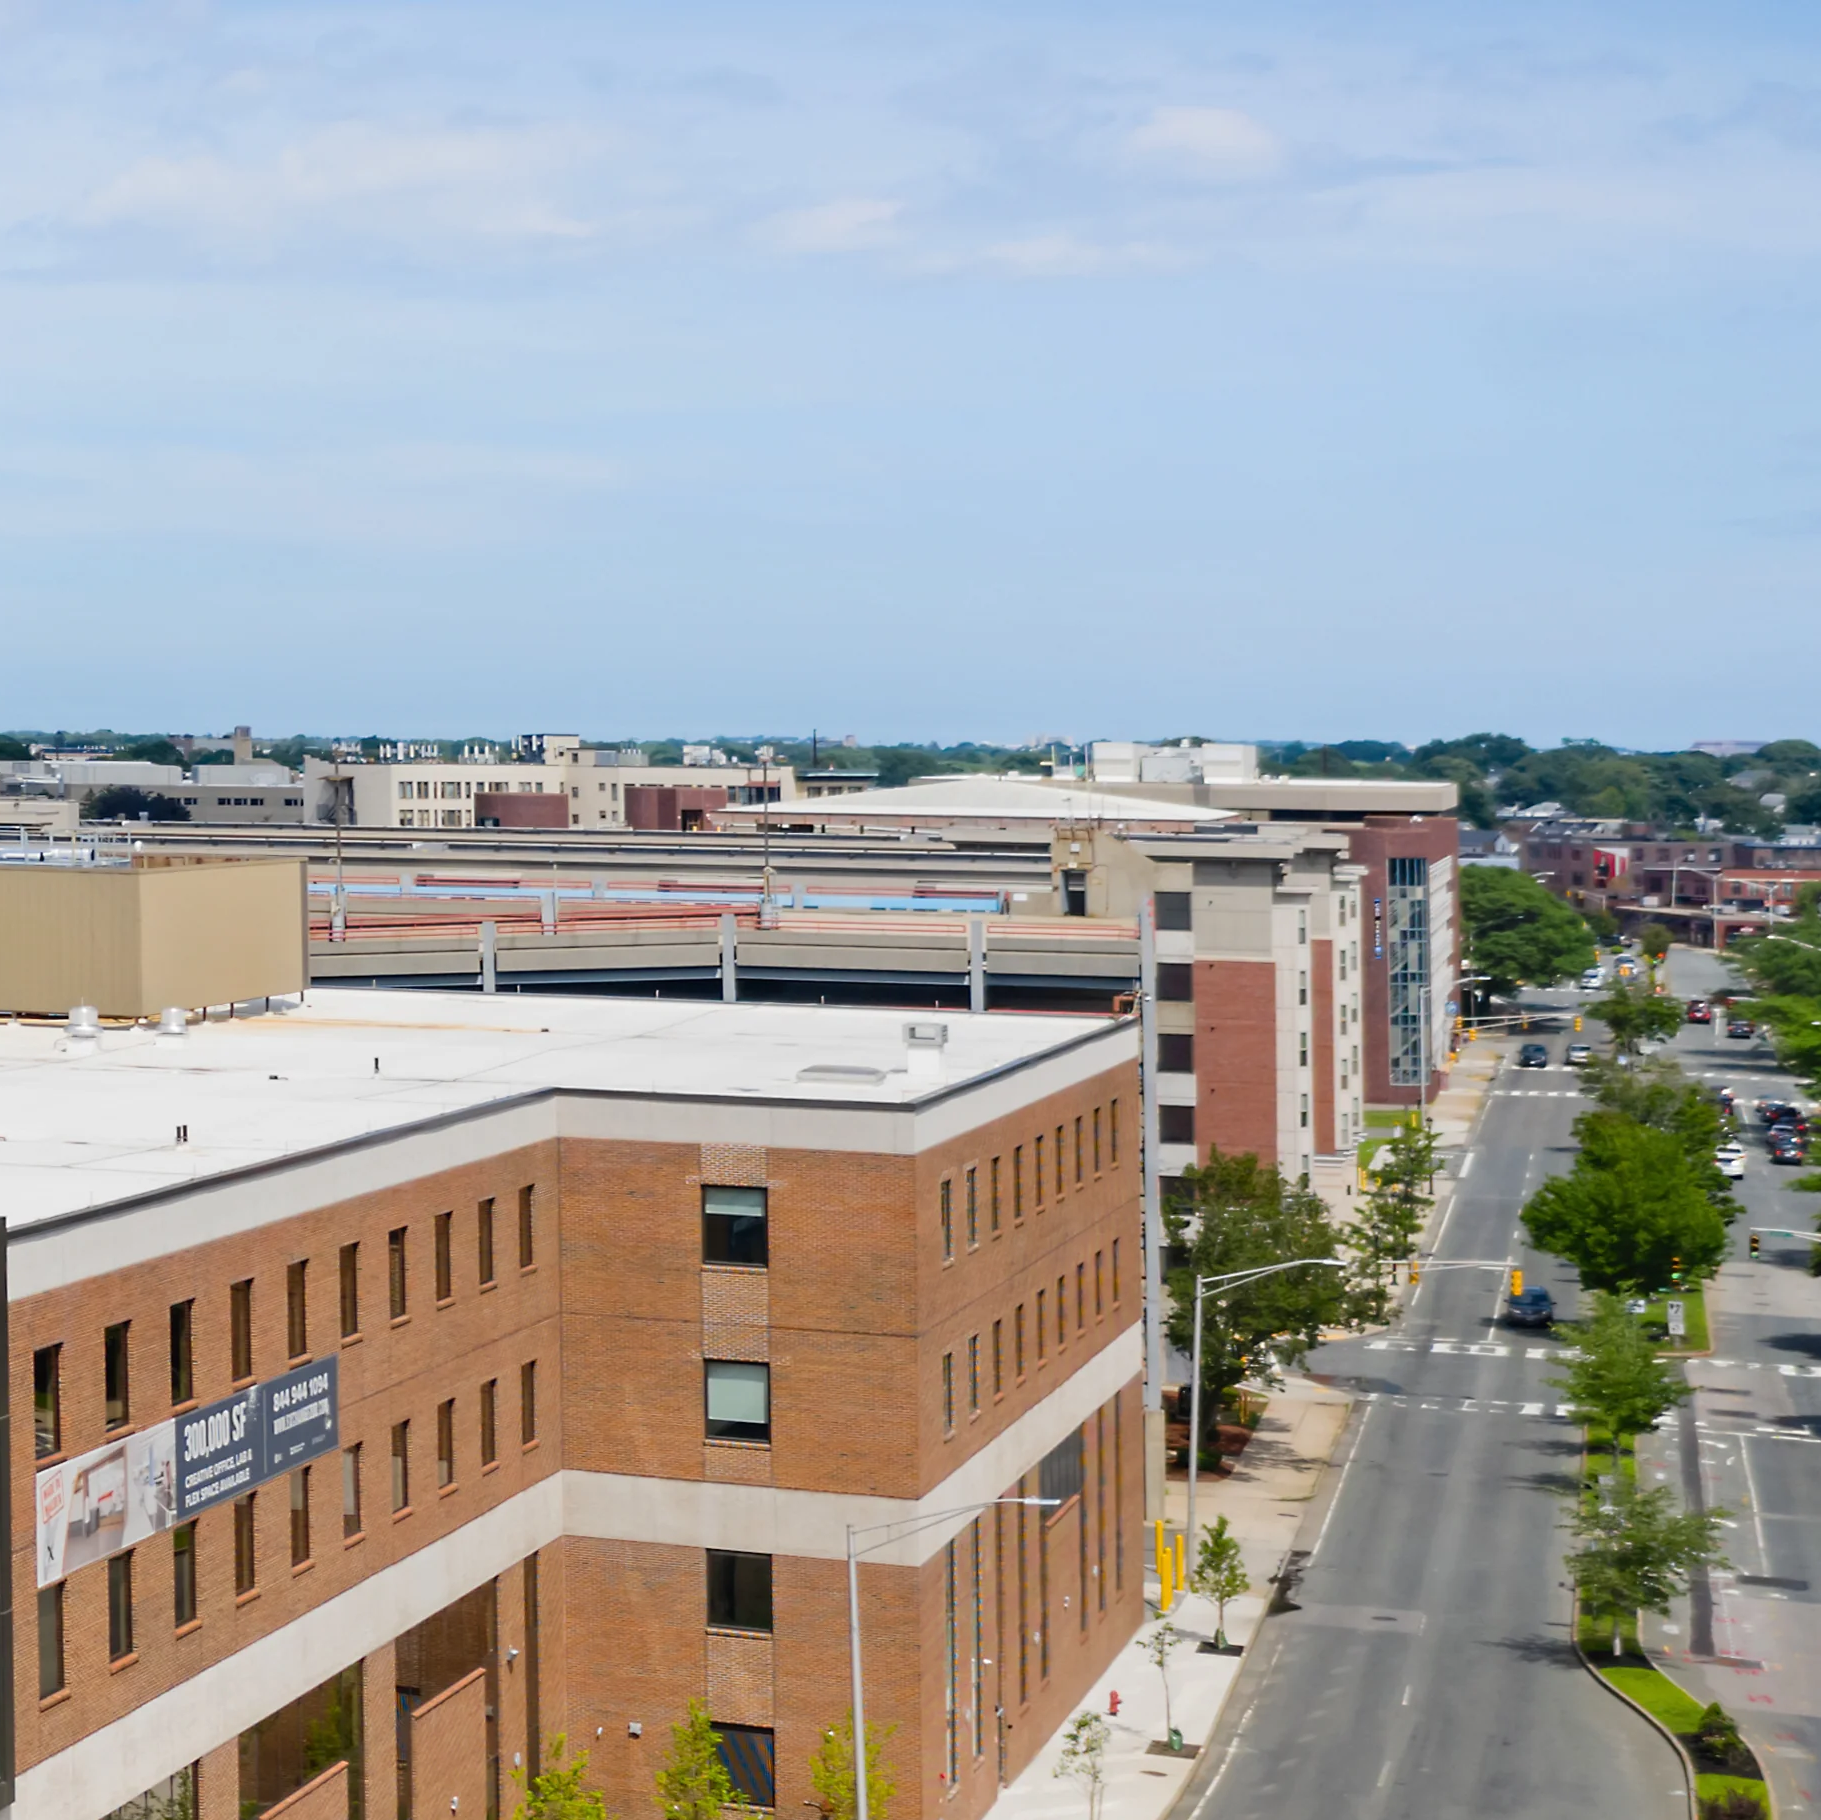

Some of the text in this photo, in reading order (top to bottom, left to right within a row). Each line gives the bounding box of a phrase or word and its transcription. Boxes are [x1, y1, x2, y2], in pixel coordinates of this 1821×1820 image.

[273, 1372, 328, 1412] 844 944 1094
[184, 1410, 230, 1461] 300,000
[232, 1401, 247, 1441] SF
[185, 1466, 214, 1488] CREATIVE
[214, 1456, 236, 1476] OFFICE,
[236, 1450, 248, 1465] LAB
[185, 1468, 251, 1508] FLEX SPACE AVAILABLE
